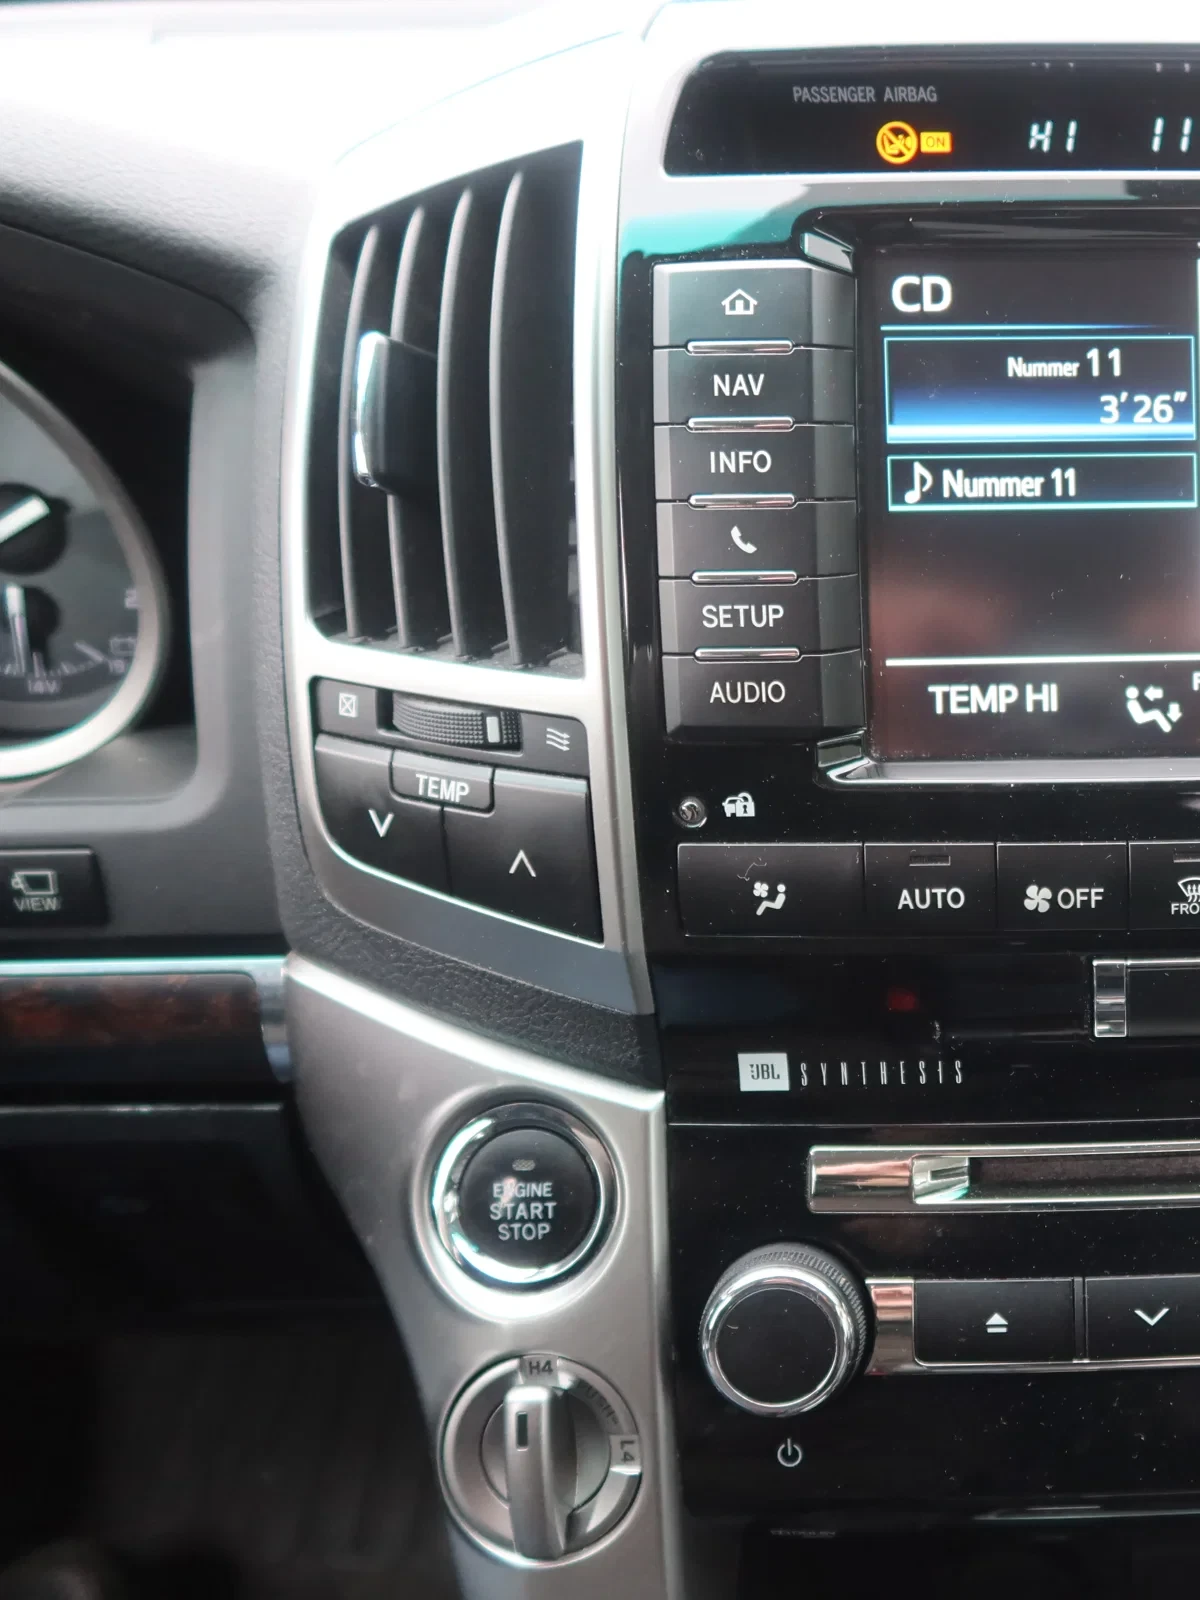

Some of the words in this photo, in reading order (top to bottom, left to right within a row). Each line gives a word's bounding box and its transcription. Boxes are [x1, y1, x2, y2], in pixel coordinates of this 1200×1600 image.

[793, 86, 876, 103] PASSENGER
[884, 86, 938, 102] AIRBAG
[925, 135, 946, 149] ON
[891, 275, 953, 313] CD
[1007, 355, 1080, 378] Nummer
[1086, 347, 1123, 377] 11
[713, 374, 765, 397] NAV
[709, 450, 772, 474] INFO
[942, 470, 1044, 498] Nummer
[1050, 468, 1077, 496] 11
[702, 605, 784, 629] SETUP
[709, 681, 786, 704] AUDIO
[928, 684, 1018, 715] TEMP
[1025, 683, 1058, 712] HI
[415, 773, 470, 804] TEMP
[13, 897, 58, 912] VIEW
[897, 888, 966, 910] AUTO
[1057, 888, 1104, 909] OFF
[751, 1063, 781, 1080] JBL
[800, 1060, 963, 1087] SYNTHESIS
[489, 1202, 557, 1220] START
[498, 1223, 551, 1241] STOP
[528, 1360, 554, 1375] H4
[619, 1438, 635, 1463] L4
